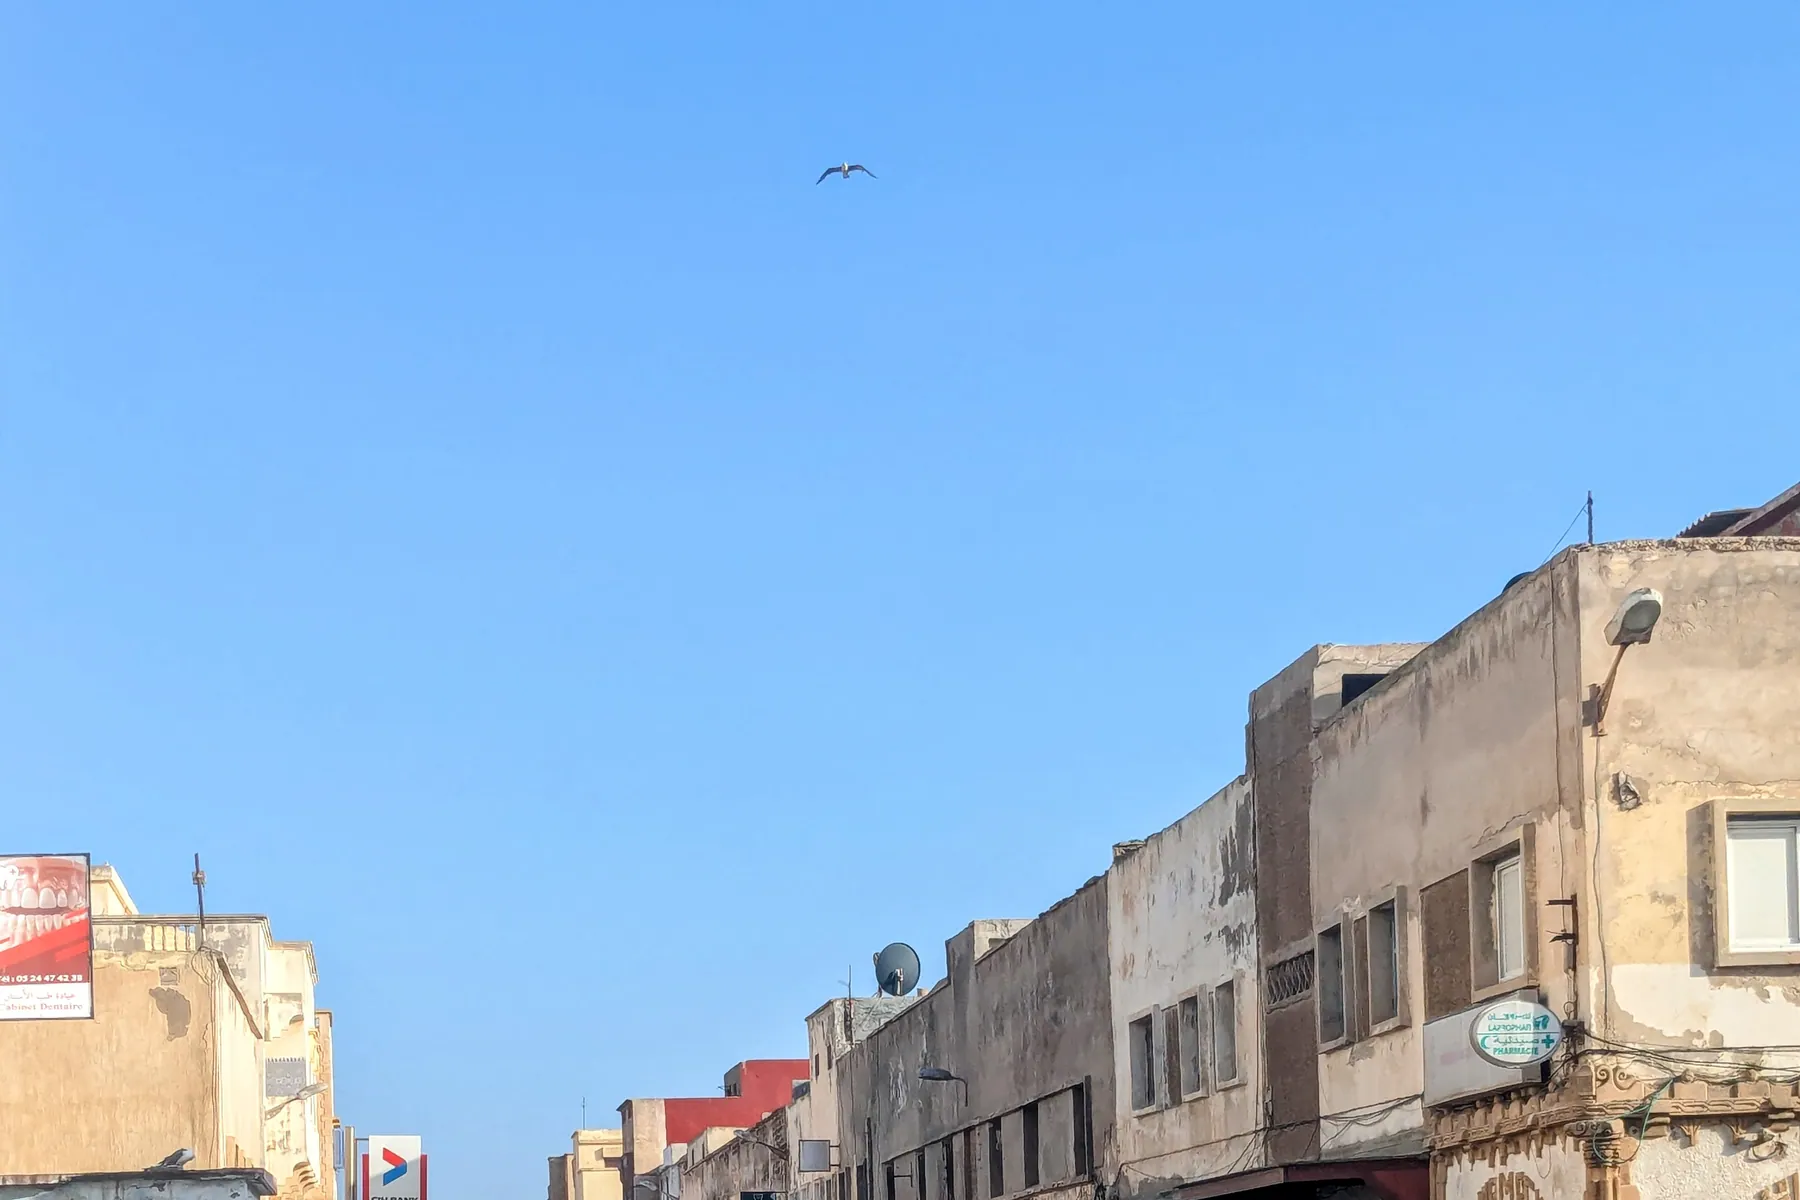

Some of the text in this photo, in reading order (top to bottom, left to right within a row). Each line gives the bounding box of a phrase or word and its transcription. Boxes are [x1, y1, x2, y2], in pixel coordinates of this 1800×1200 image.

[16, 974, 28, 983] 05
[30, 974, 42, 982] 24
[43, 974, 56, 982] 47
[57, 974, 69, 982] 42
[71, 974, 83, 982] 38
[40, 1003, 83, 1011] Dentaire
[1493, 1036, 1540, 1047] صيدلية
[1493, 1047, 1539, 1056] PHARMACIE
